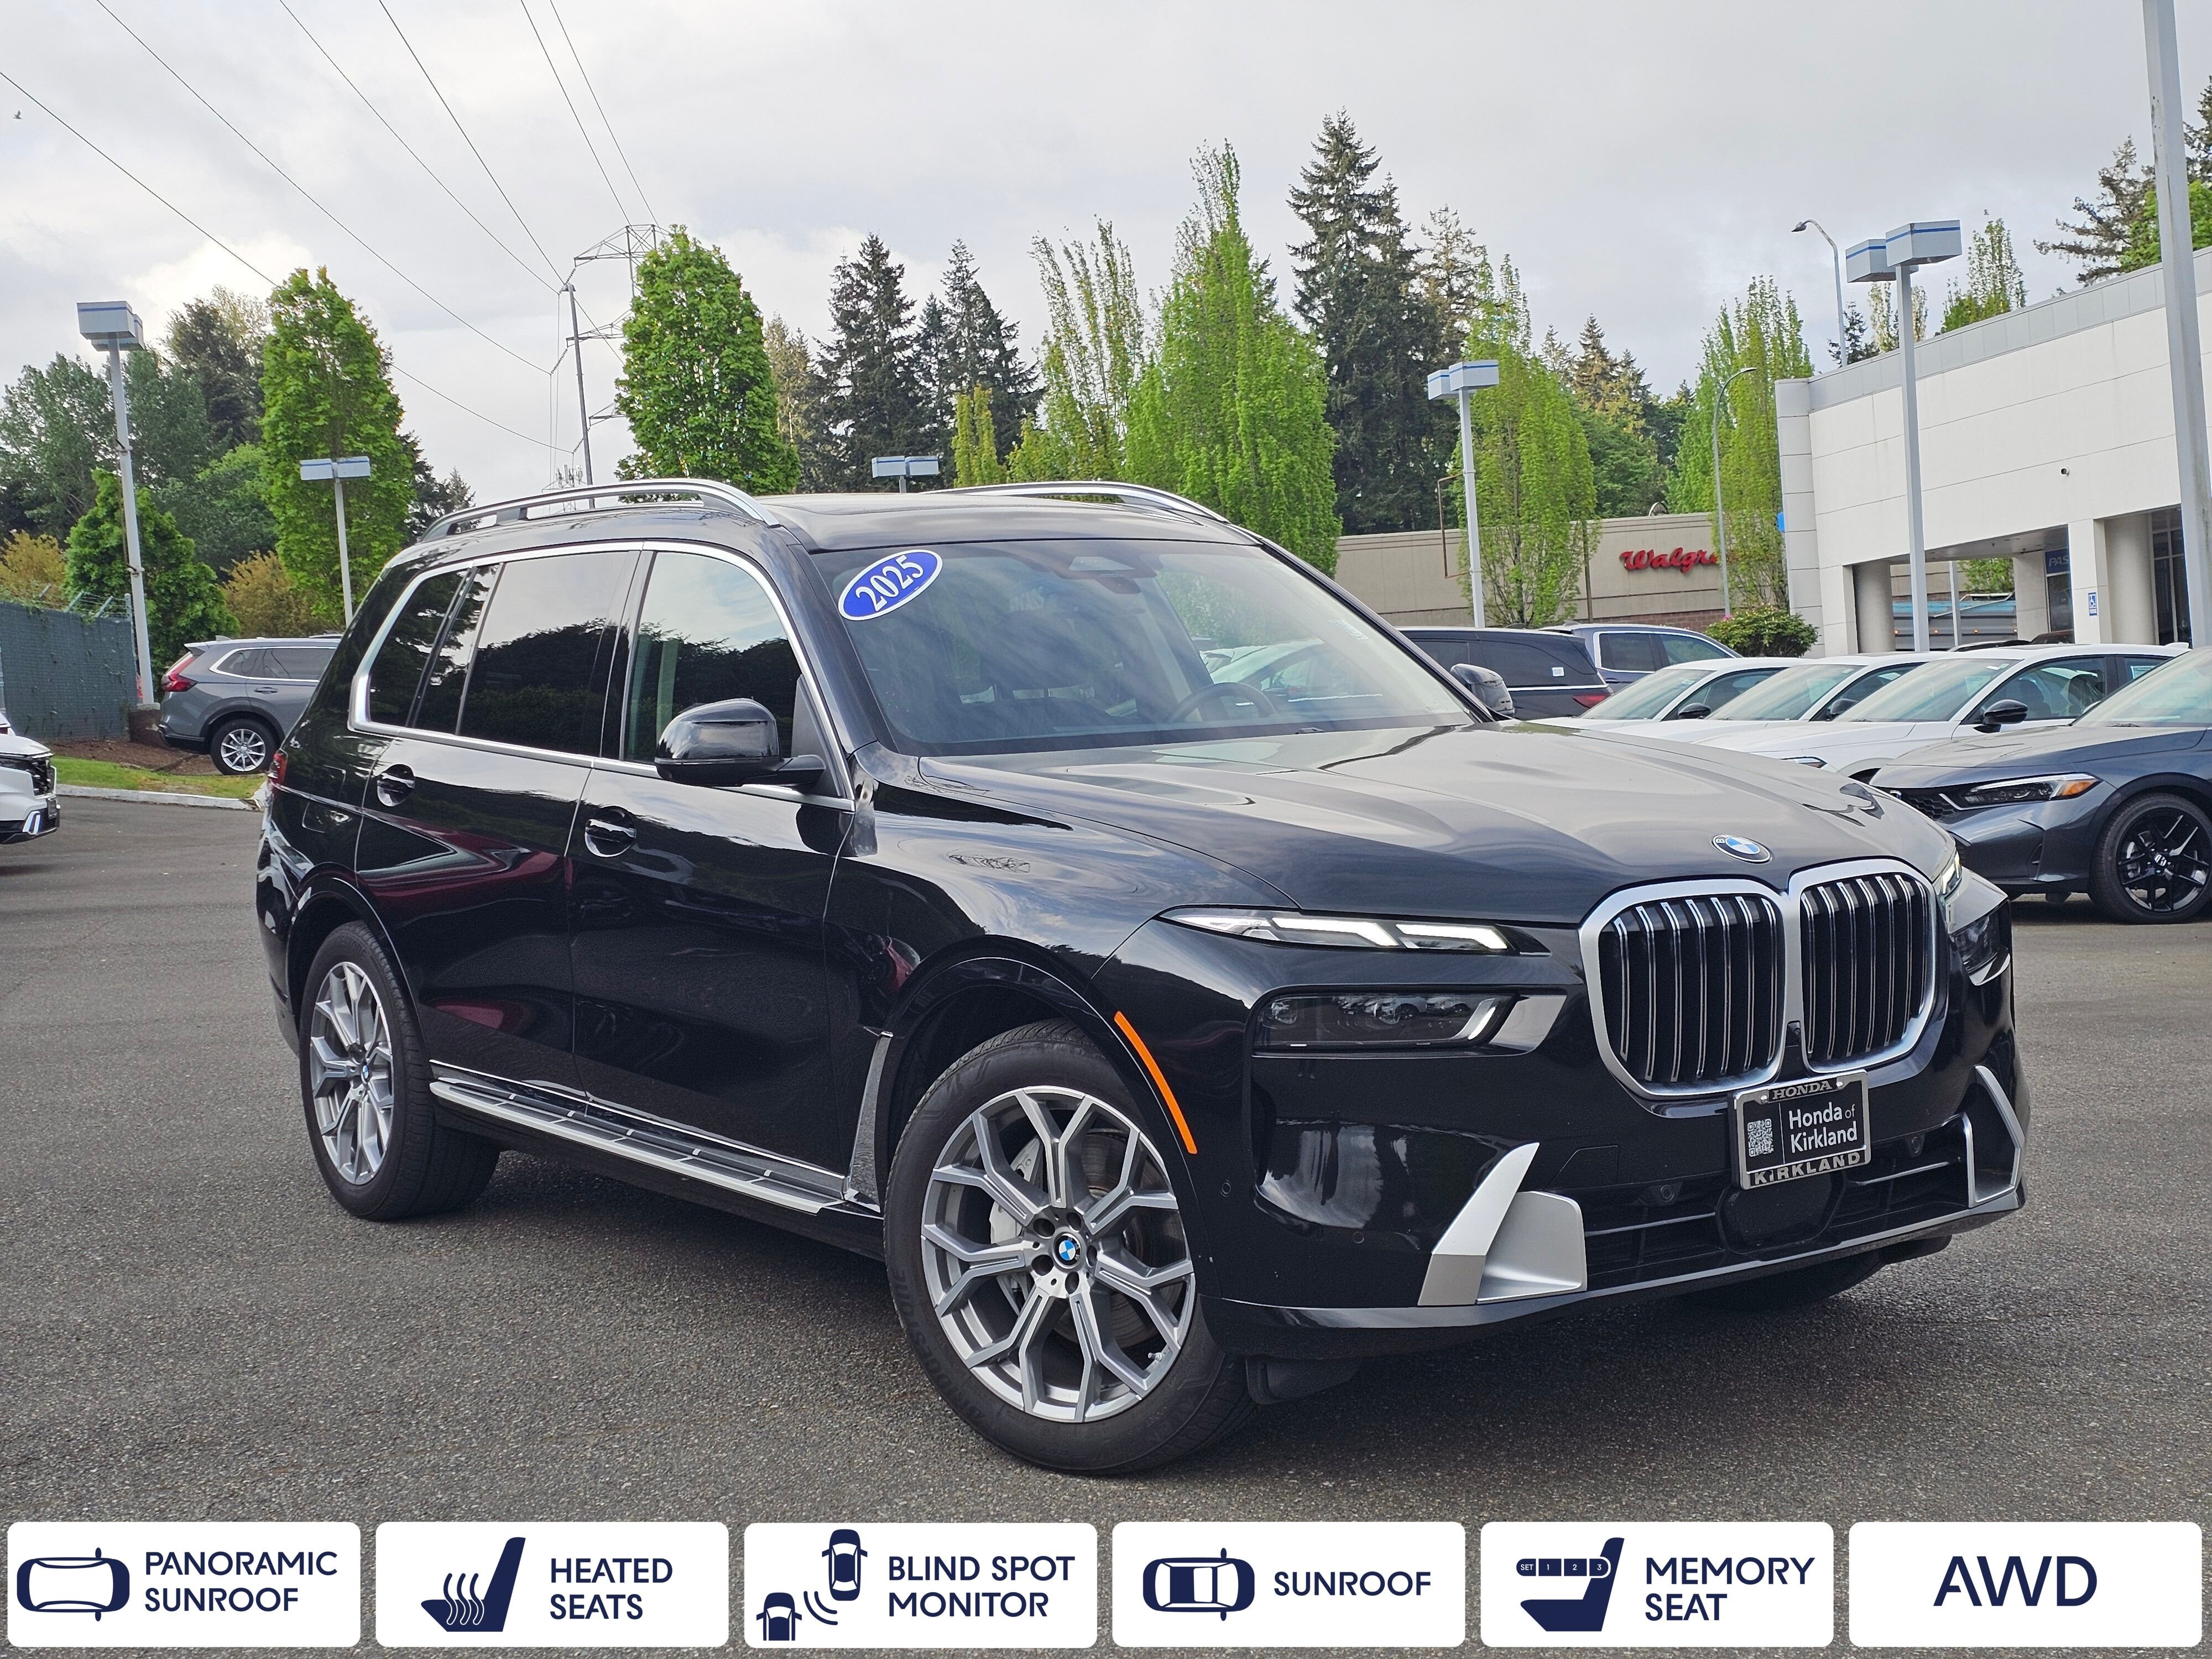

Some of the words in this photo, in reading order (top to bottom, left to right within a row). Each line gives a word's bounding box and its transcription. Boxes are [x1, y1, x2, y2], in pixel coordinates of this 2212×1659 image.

[855, 555, 924, 612] 2025
[1772, 1081, 1833, 1100] HONDA
[1789, 1102, 1842, 1130] Honda
[1845, 1104, 1855, 1119] of
[1791, 1121, 1858, 1154] Kirkland
[1754, 1152, 1860, 1185] KIRKLAND
